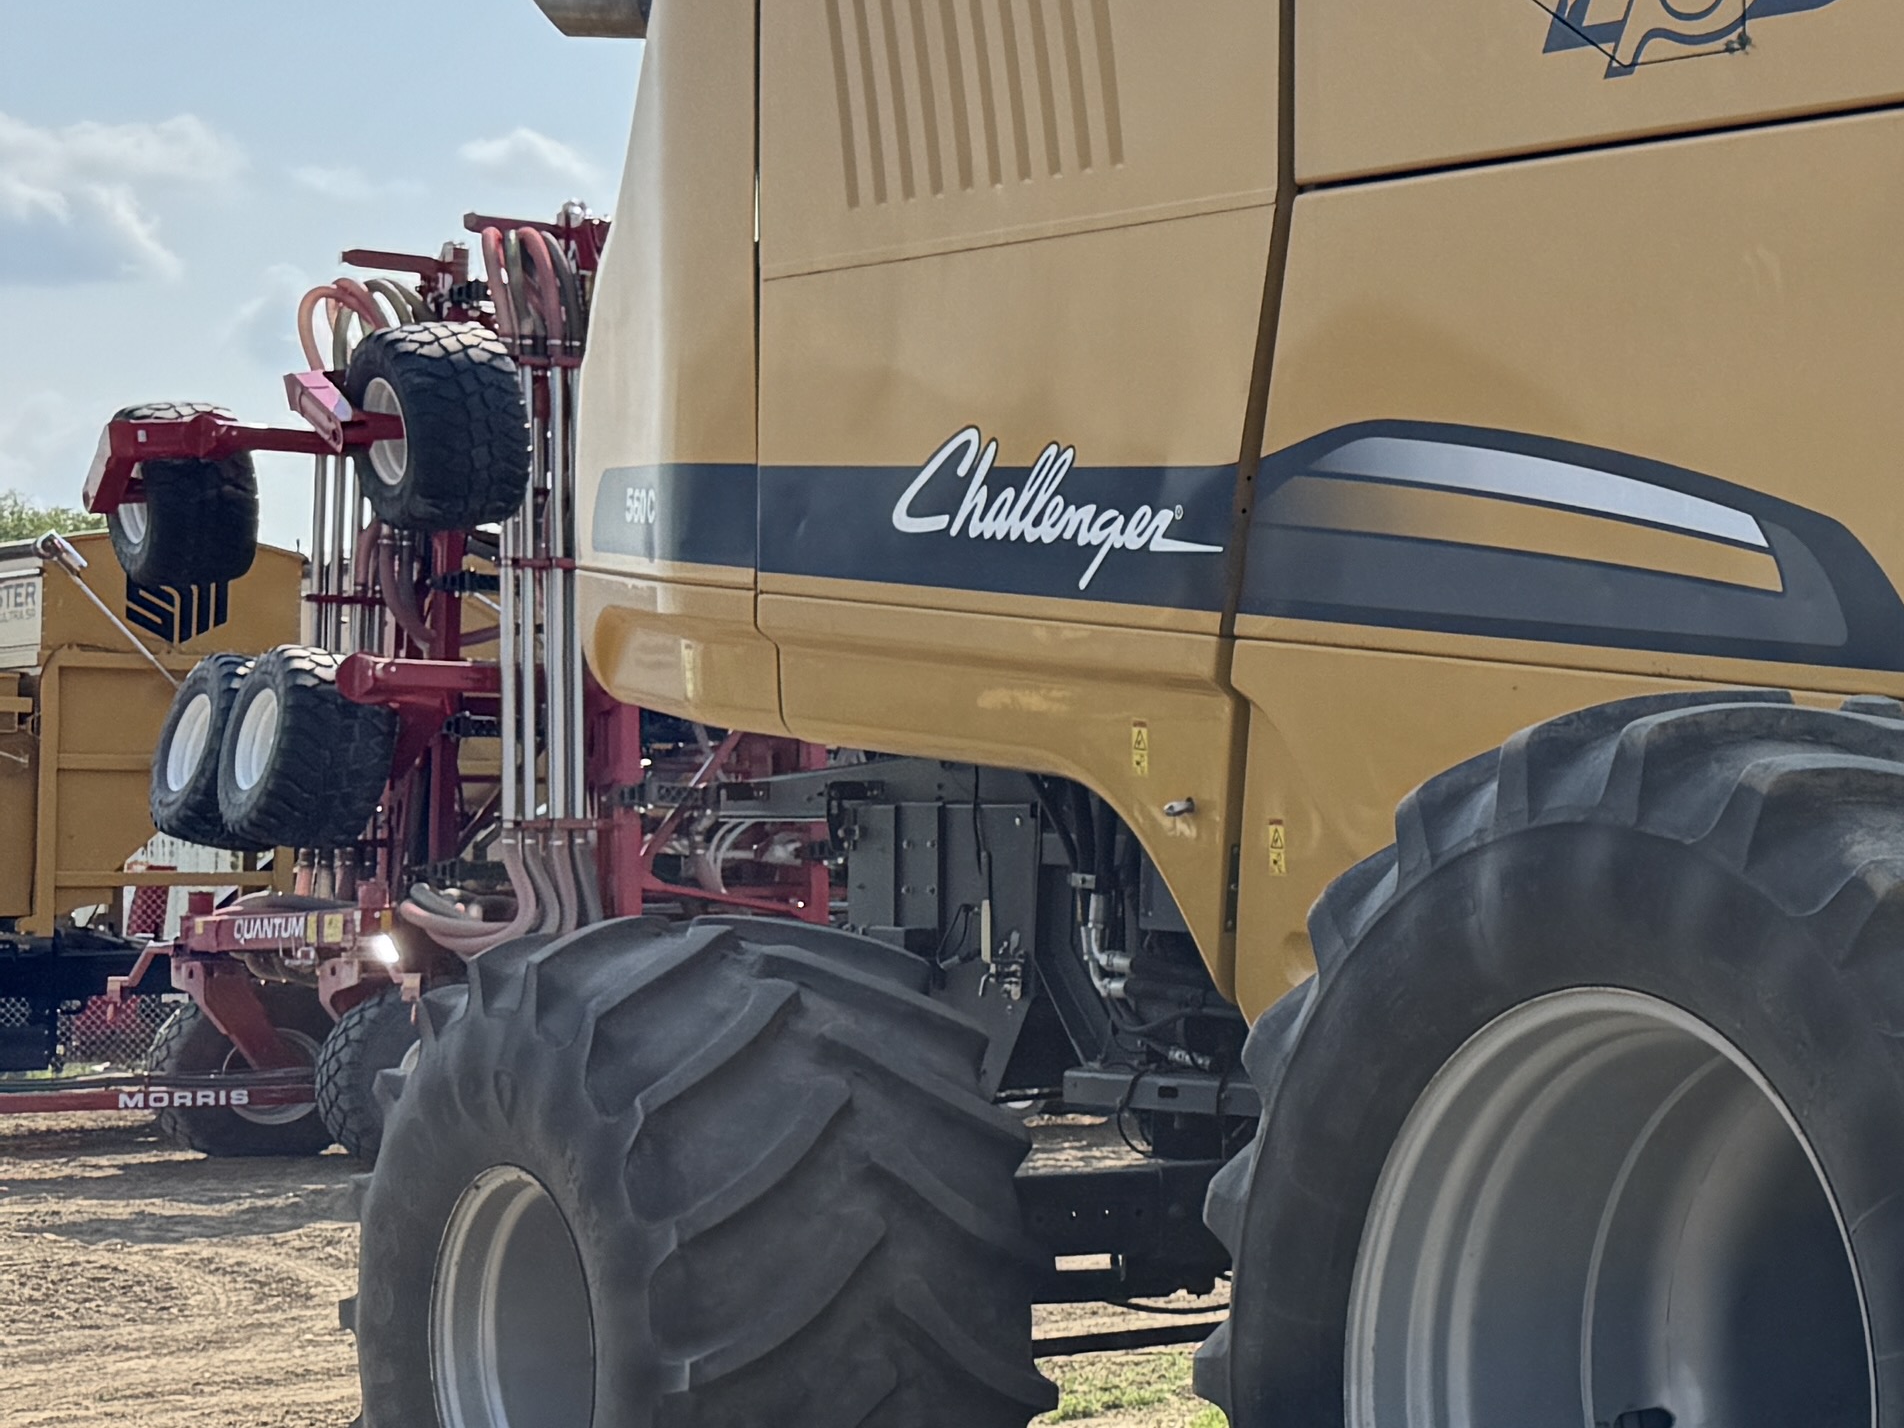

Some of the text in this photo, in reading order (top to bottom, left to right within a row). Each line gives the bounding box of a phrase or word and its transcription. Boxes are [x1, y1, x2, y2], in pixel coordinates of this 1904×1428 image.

[892, 426, 1224, 591] Challenger
[0, 582, 36, 609] TER
[233, 916, 305, 945] QUANTUM
[118, 1089, 249, 1109] MORRIS
